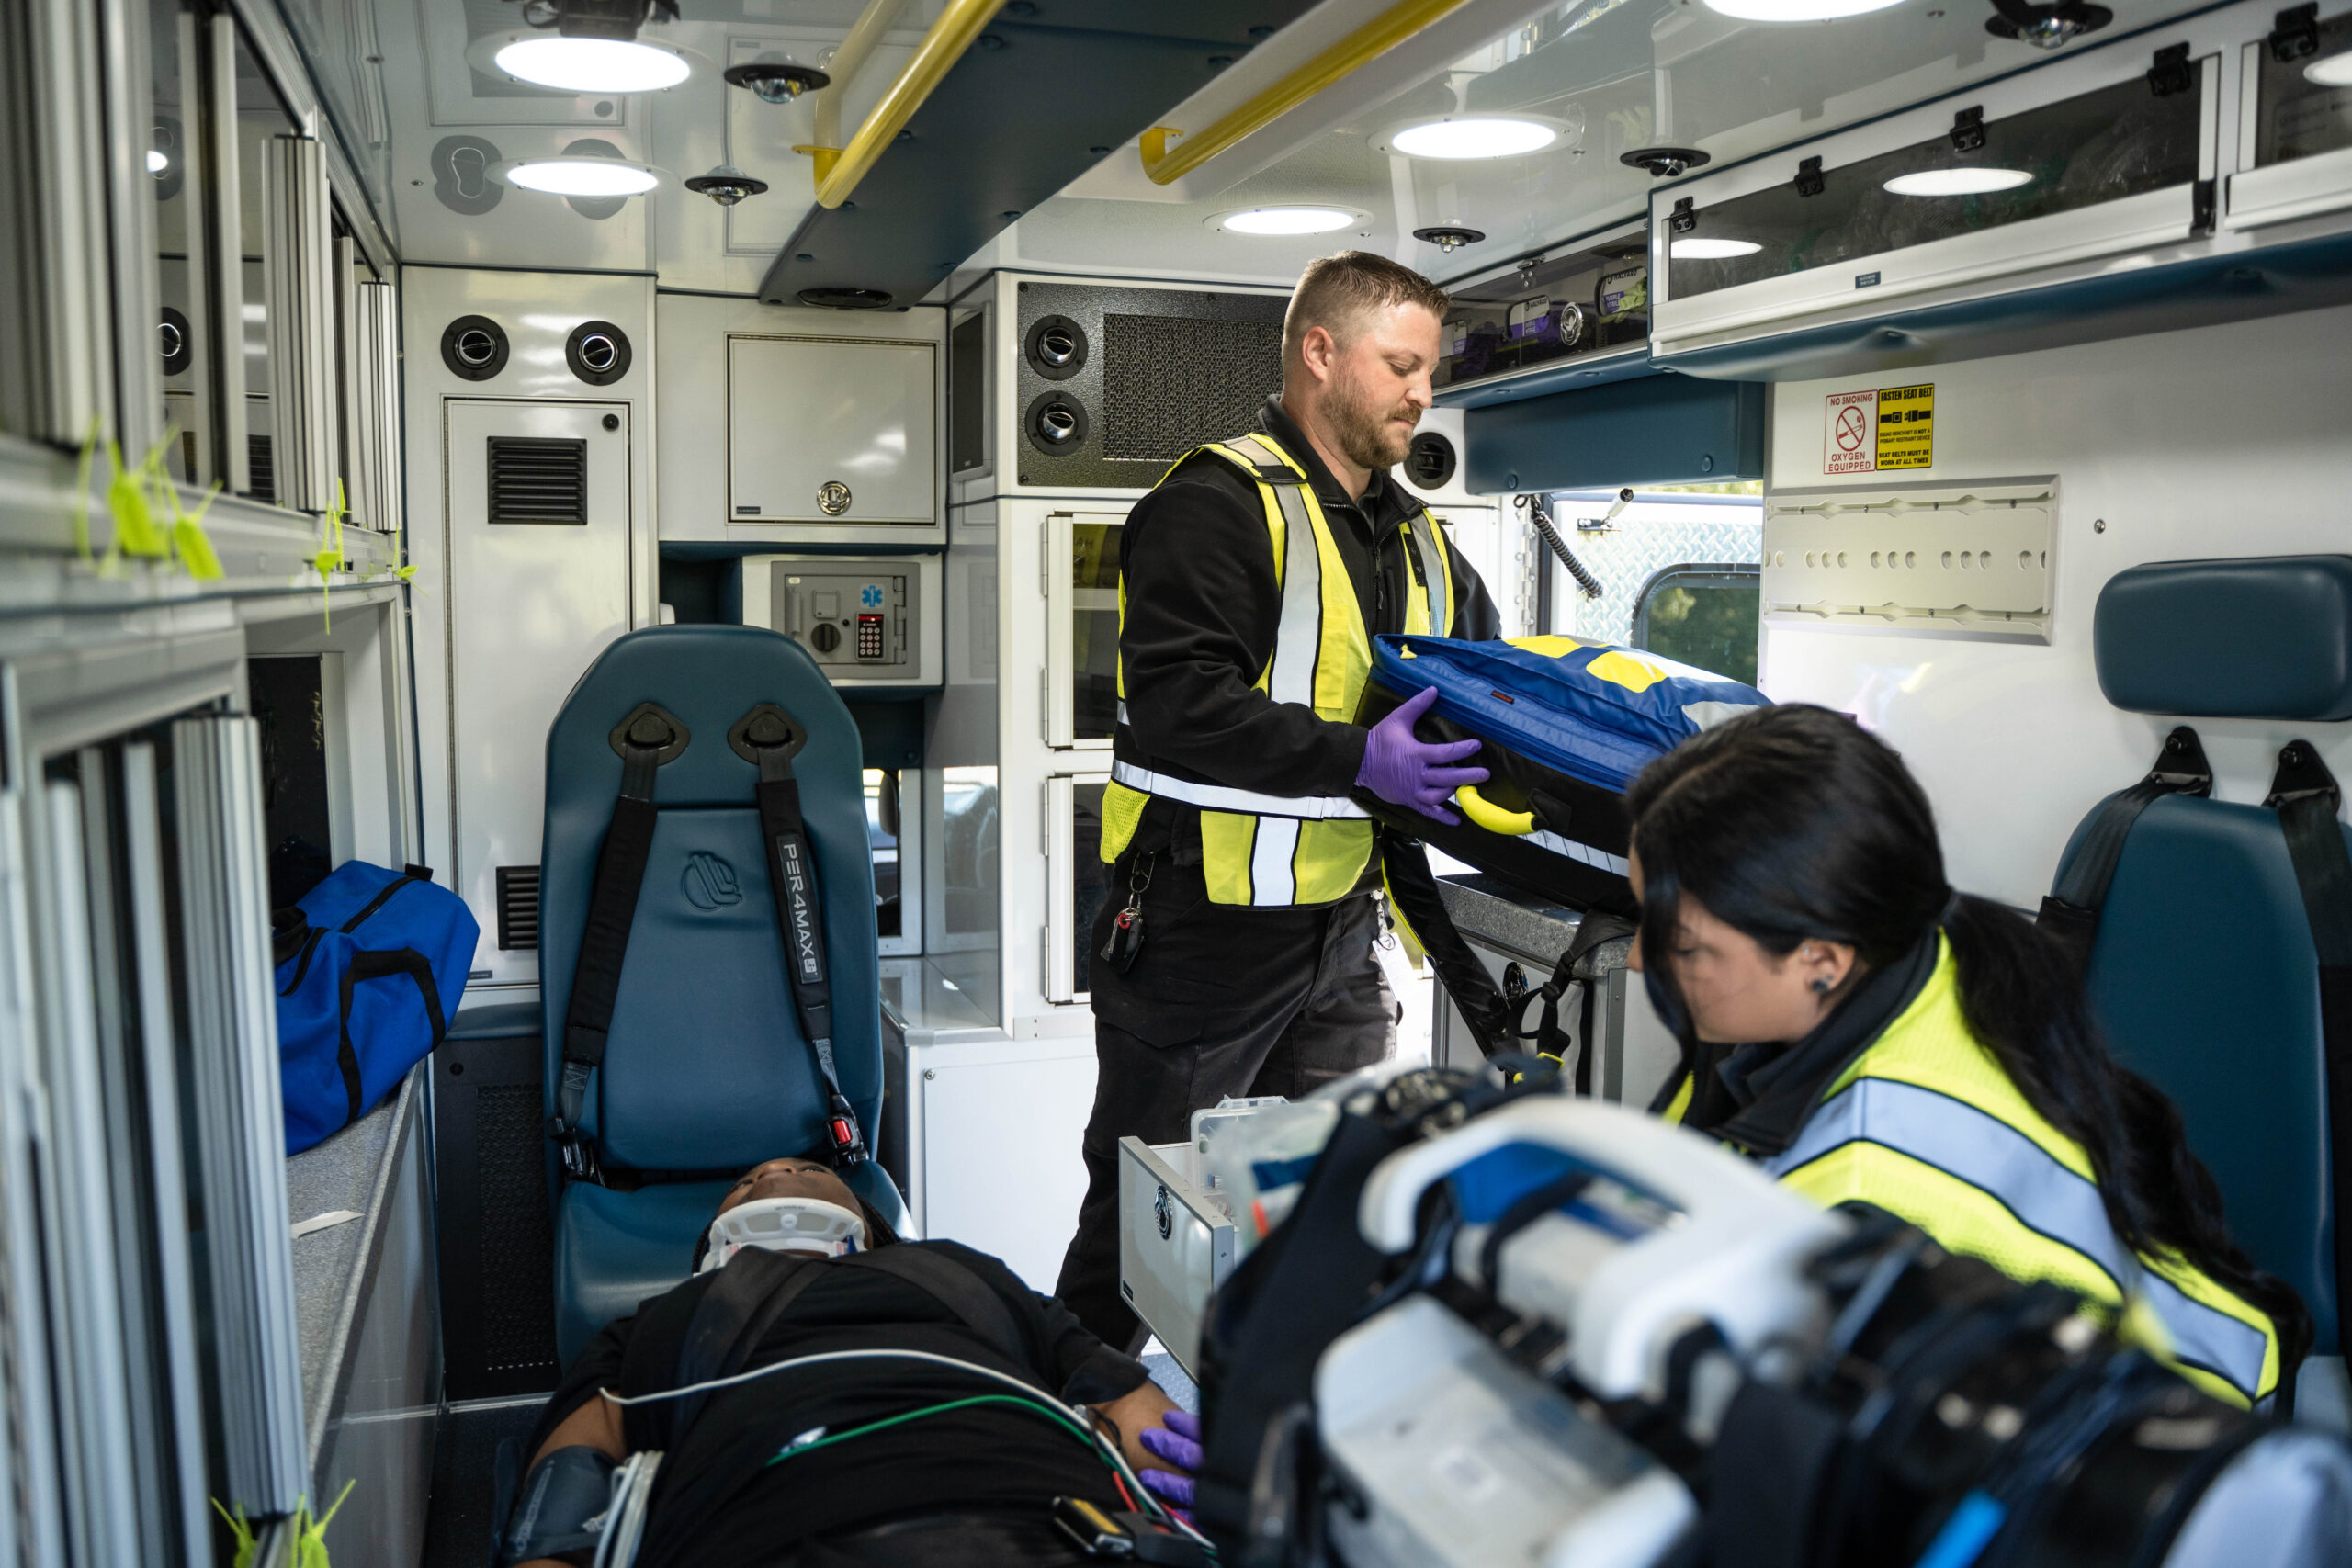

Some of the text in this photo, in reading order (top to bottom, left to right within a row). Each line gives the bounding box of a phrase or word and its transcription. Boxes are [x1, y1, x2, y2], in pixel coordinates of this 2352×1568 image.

[1830, 393, 1873, 406] NO SMOKING
[1881, 387, 1932, 401] FASTEN SEAT BELT
[1831, 451, 1865, 462] OXYGEN
[1828, 461, 1871, 472] EQUIPPED
[784, 843, 815, 957] PER4MAX
